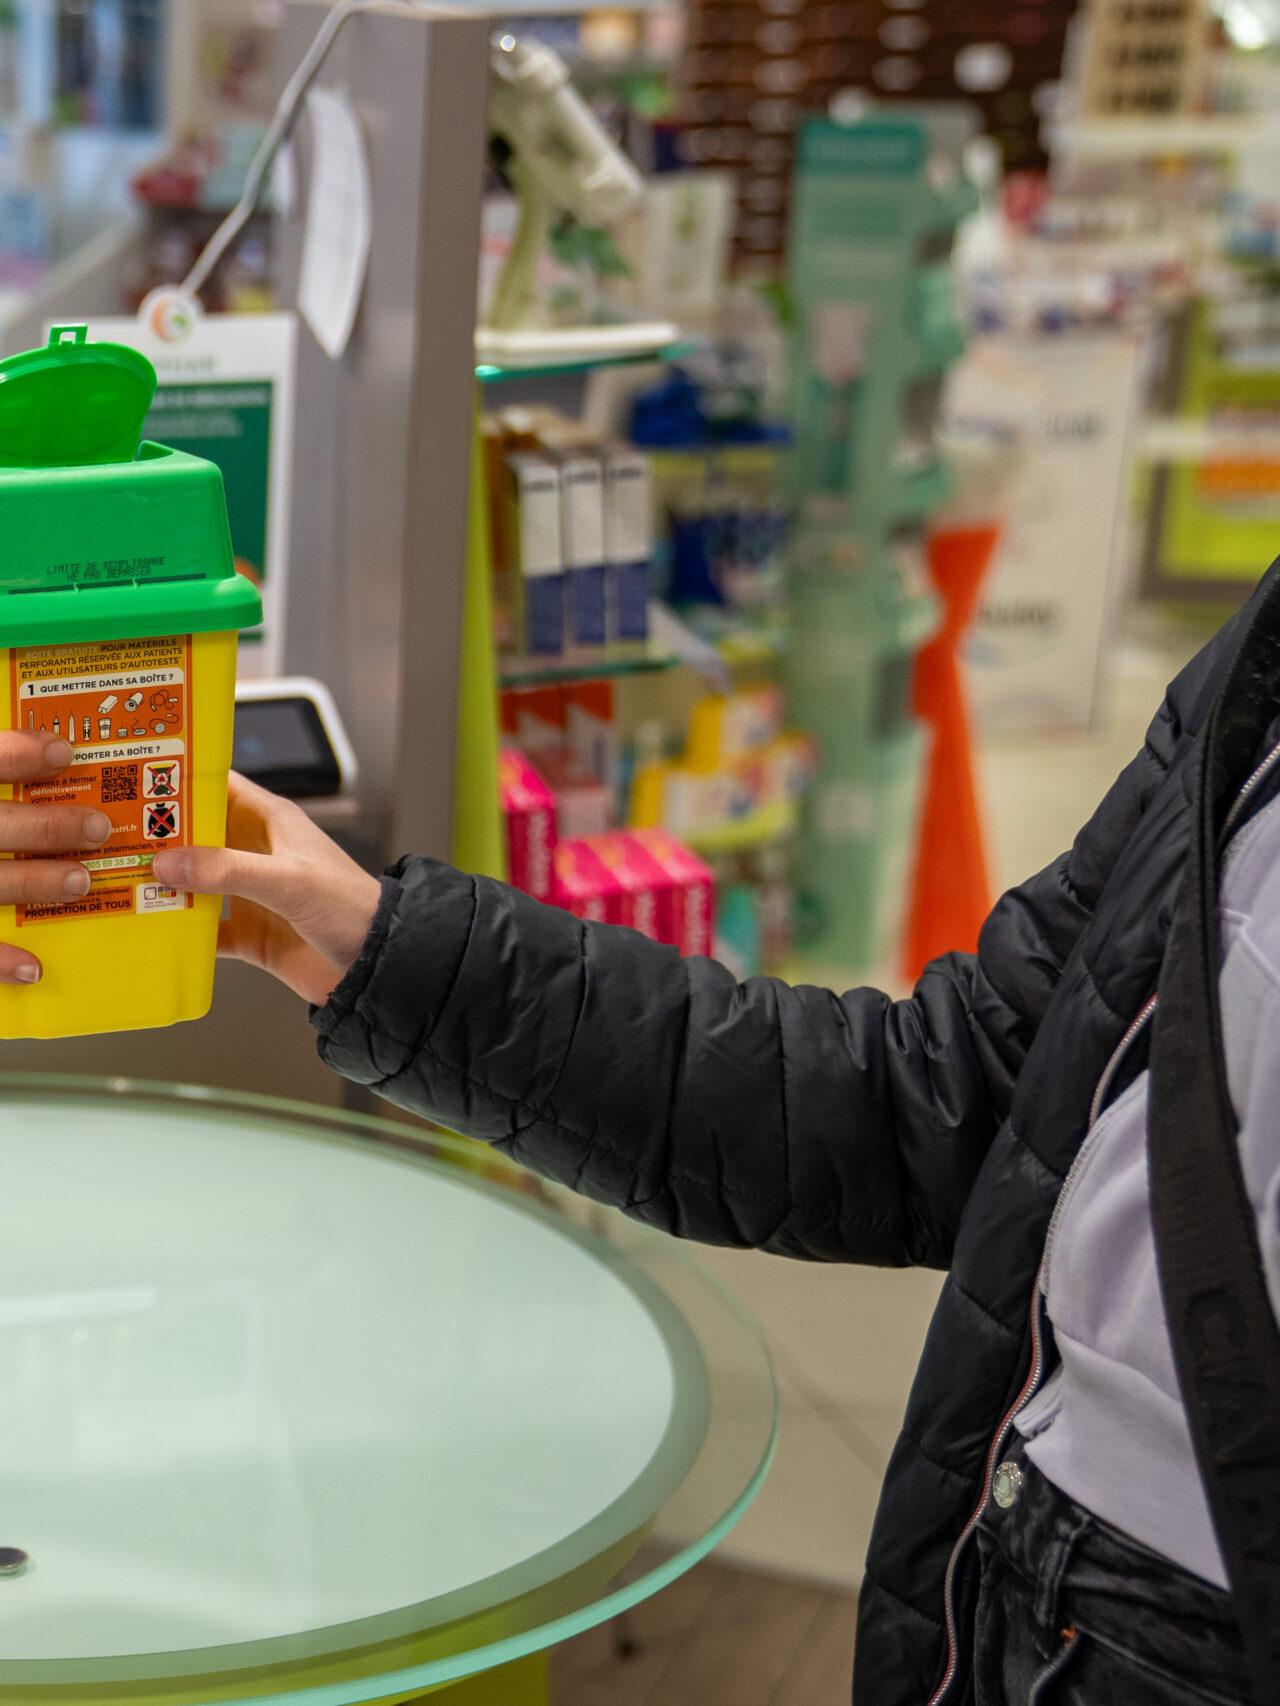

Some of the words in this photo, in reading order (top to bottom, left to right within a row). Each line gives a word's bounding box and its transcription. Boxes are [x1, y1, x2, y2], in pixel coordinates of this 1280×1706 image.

[46, 563, 80, 575] LIMITE
[87, 562, 98, 570] DE
[104, 556, 165, 569] REMPLISSAGE
[67, 572, 78, 581] NE
[84, 570, 100, 580] PAS
[55, 646, 99, 657] GRATUITE
[101, 643, 126, 652] POUR
[128, 639, 177, 650] MATÉRIELS
[20, 658, 76, 669] PERFORANTS
[79, 652, 121, 664] RÉSERVÉE
[124, 651, 141, 660] AUX
[144, 647, 183, 657] PATIENTS
[22, 671, 33, 679] ET
[36, 669, 54, 677] AUX
[57, 663, 118, 675] UTILISATEURS
[28, 684, 34, 695] 1
[40, 685, 59, 693] QUE
[62, 680, 97, 691] METTRE
[99, 679, 124, 687] DANS
[126, 677, 138, 685] SA
[140, 673, 167, 684] BOÎTE
[169, 673, 174, 681] ?
[73, 750, 111, 761] PORTER
[113, 749, 125, 757] SA
[127, 746, 154, 756] BOÎTE
[70, 775, 97, 784] fermer
[31, 784, 92, 796] définitivement
[31, 796, 52, 804] votre
[104, 842, 154, 853] pharmacien,
[25, 904, 87, 918] PROTECTION
[90, 902, 102, 911] DE
[105, 899, 131, 910] TOUS
